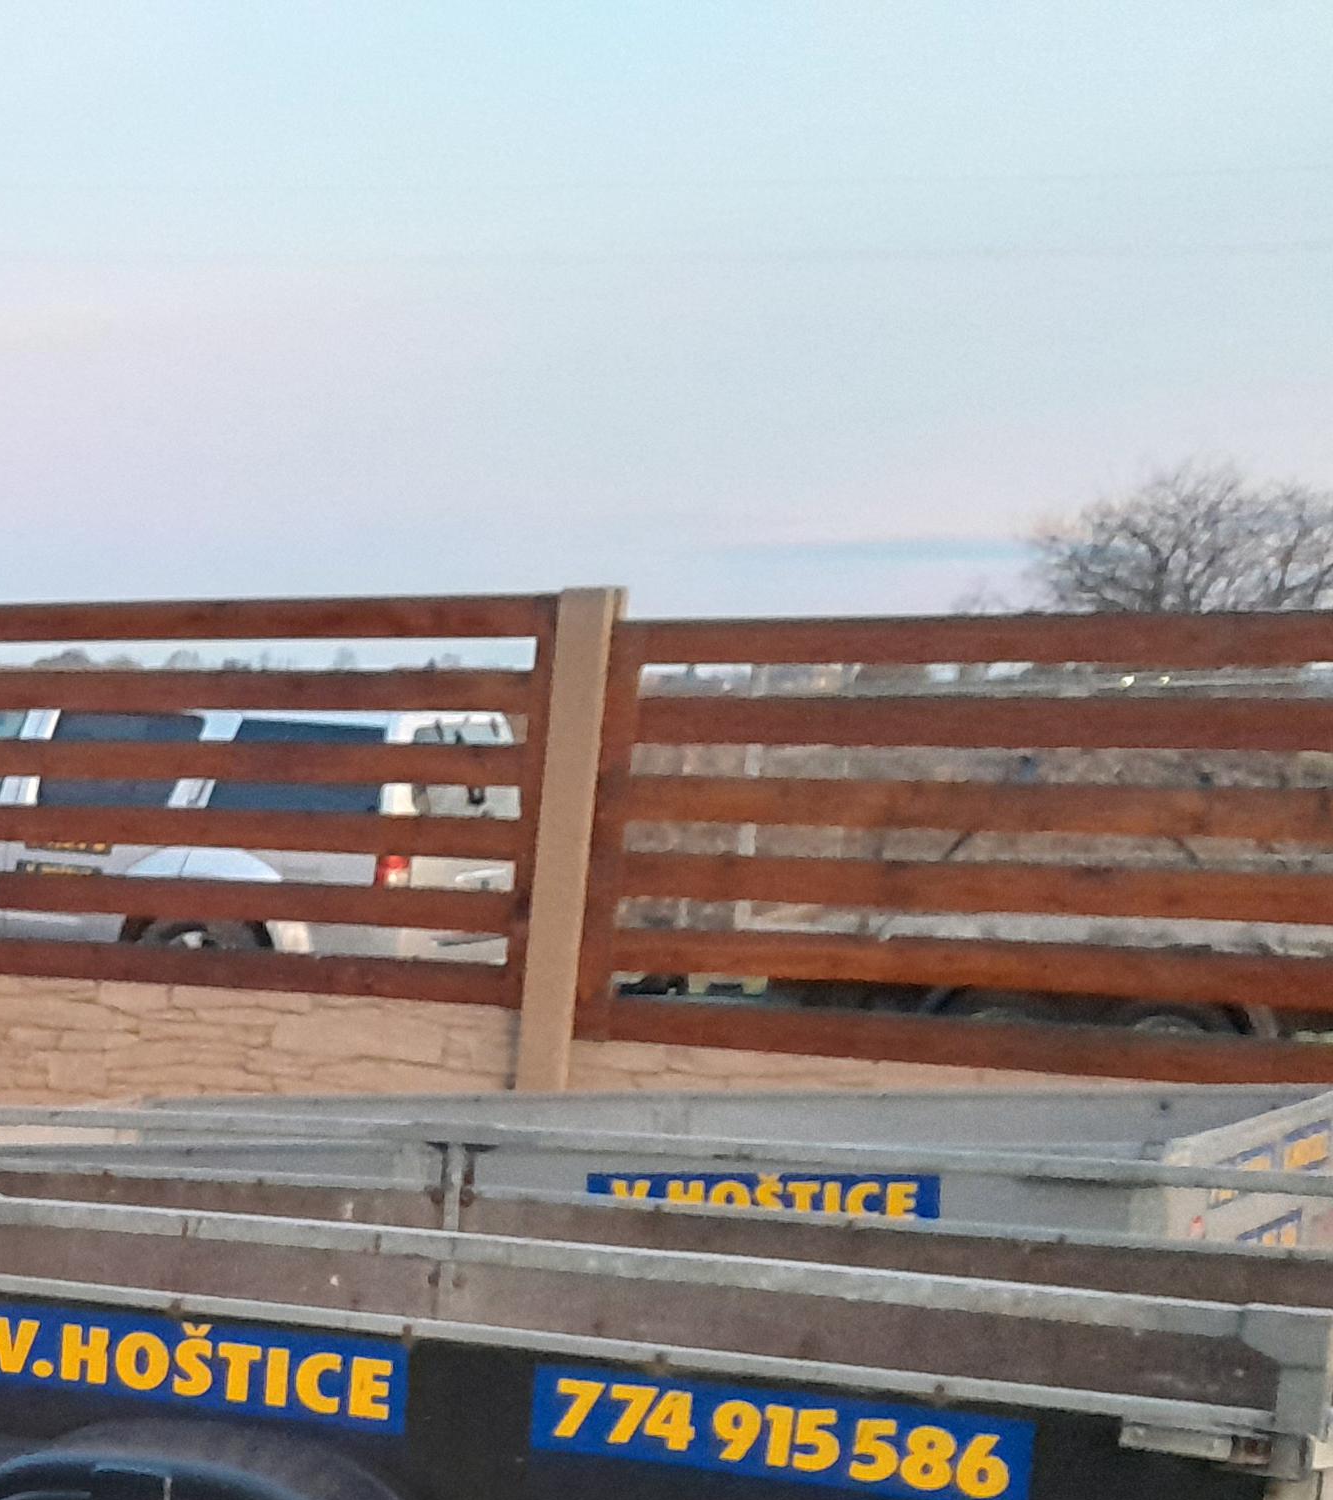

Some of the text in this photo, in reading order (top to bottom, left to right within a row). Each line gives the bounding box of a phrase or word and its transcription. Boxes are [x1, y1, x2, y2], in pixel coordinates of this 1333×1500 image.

[554, 1378, 1010, 1498] 774 915 586
